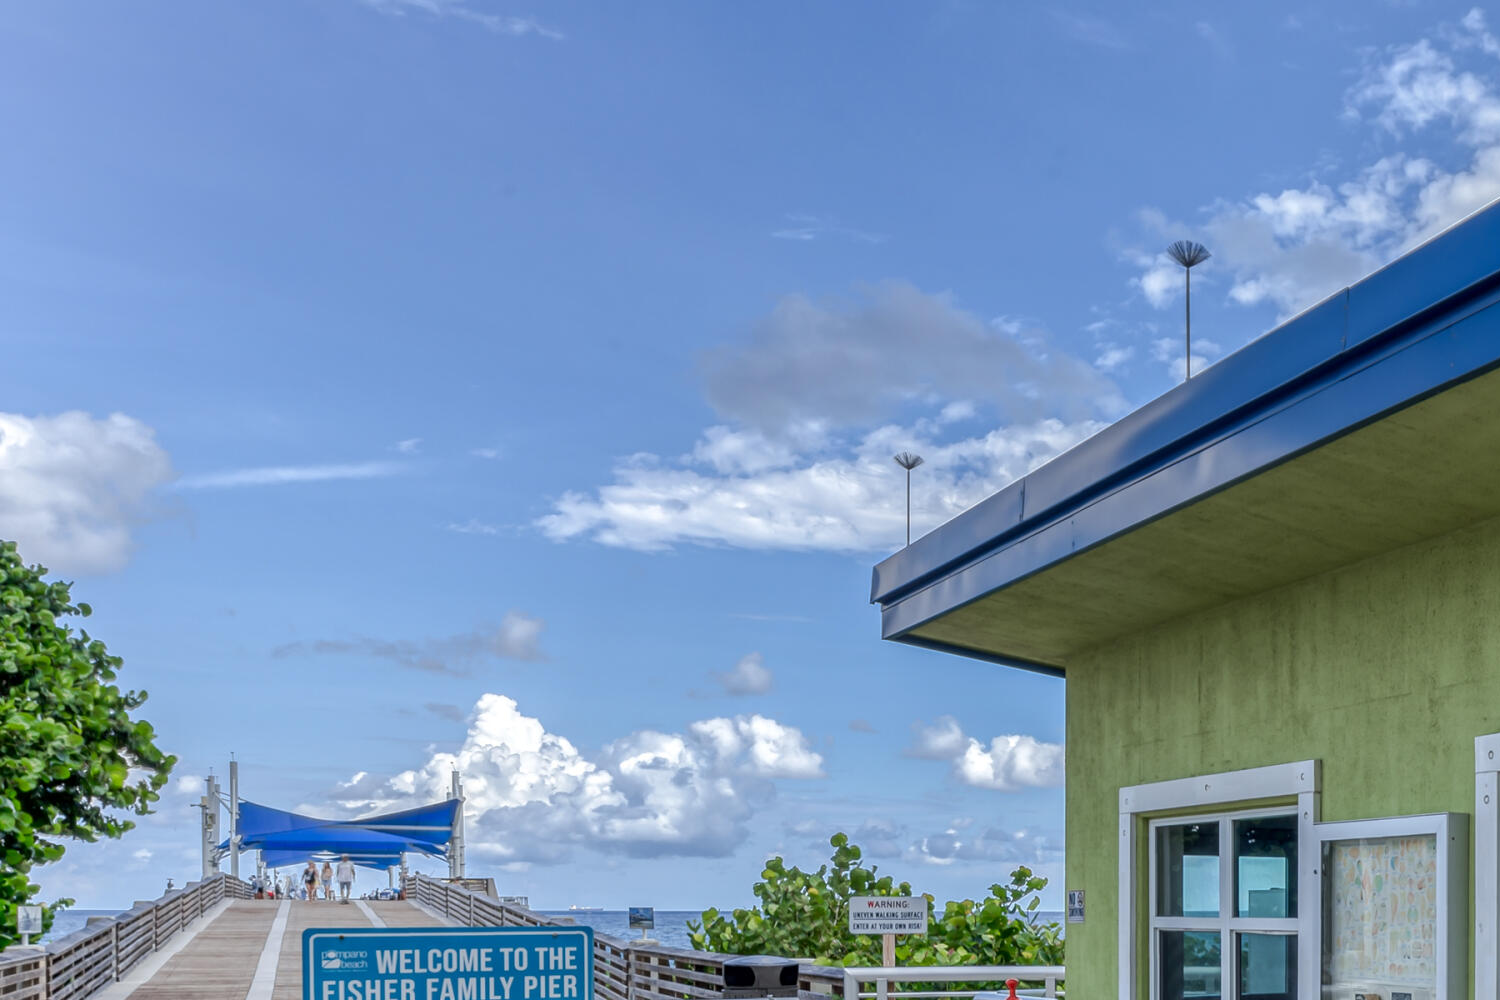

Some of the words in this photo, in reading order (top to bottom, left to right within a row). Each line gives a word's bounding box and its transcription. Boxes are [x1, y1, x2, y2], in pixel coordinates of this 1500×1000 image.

[868, 900, 910, 909] WARNING:
[900, 912, 924, 920] SURFACE
[340, 959, 368, 969] beach
[376, 948, 493, 975] WELCOME
[500, 947, 529, 972] TO
[535, 946, 578, 971] THE
[524, 974, 578, 1000] PIER
